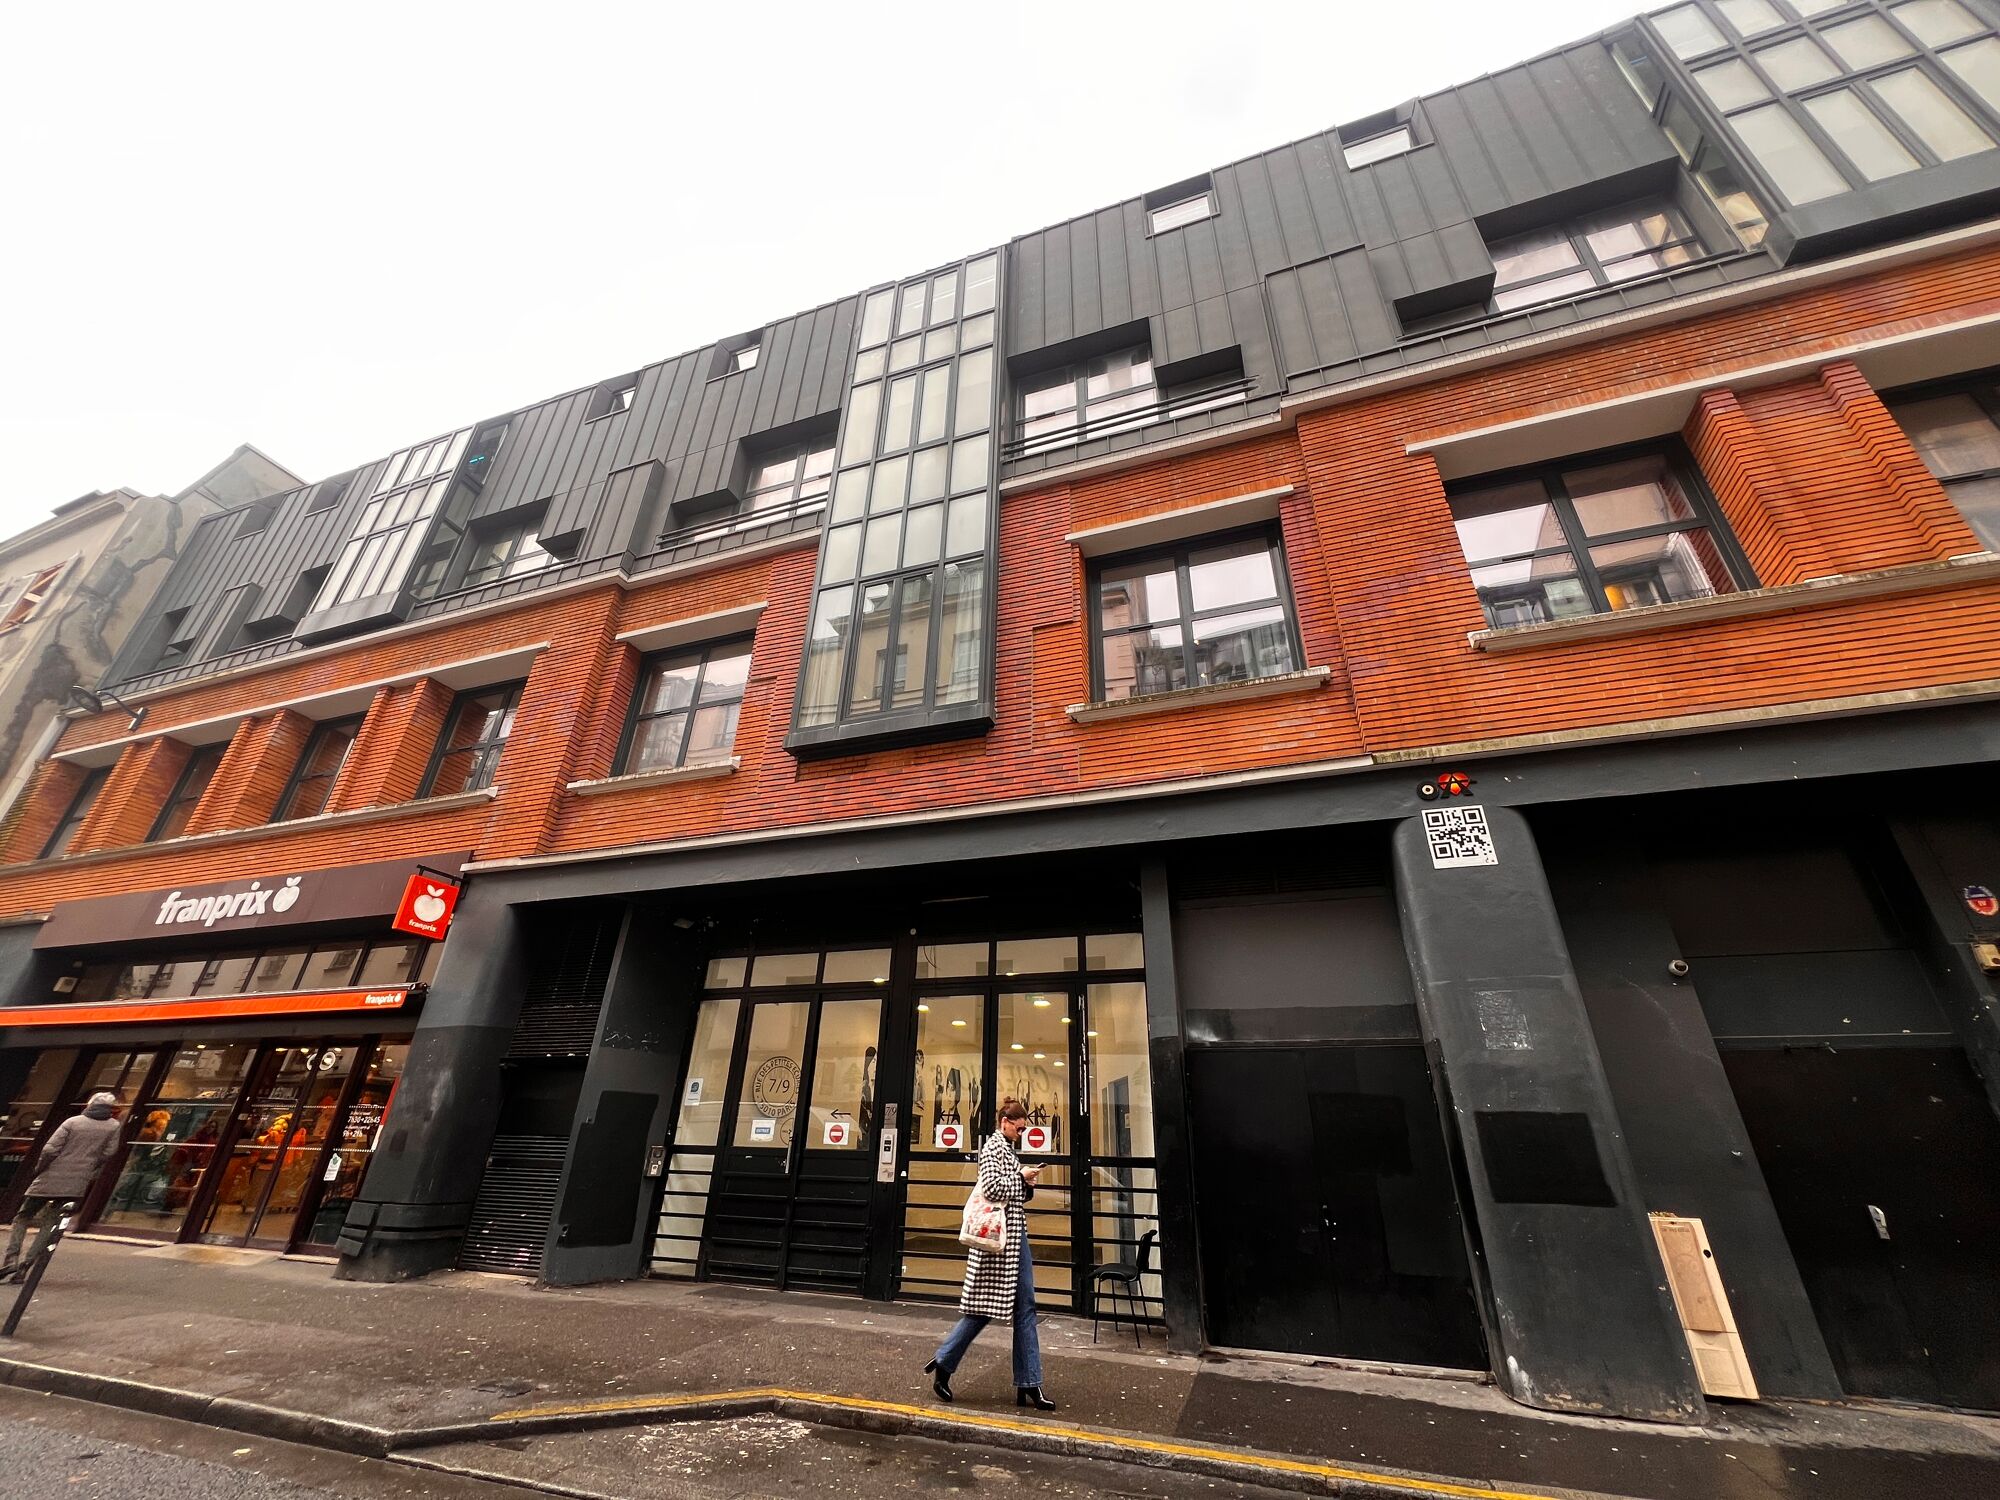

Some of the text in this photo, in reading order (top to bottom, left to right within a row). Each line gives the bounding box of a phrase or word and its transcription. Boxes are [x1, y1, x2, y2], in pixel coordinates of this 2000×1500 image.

[155, 881, 273, 927] franprix
[408, 919, 437, 932] franprix
[365, 993, 394, 1005] franprix
[760, 1063, 771, 1077] DES
[769, 1078, 790, 1093] 7/9
